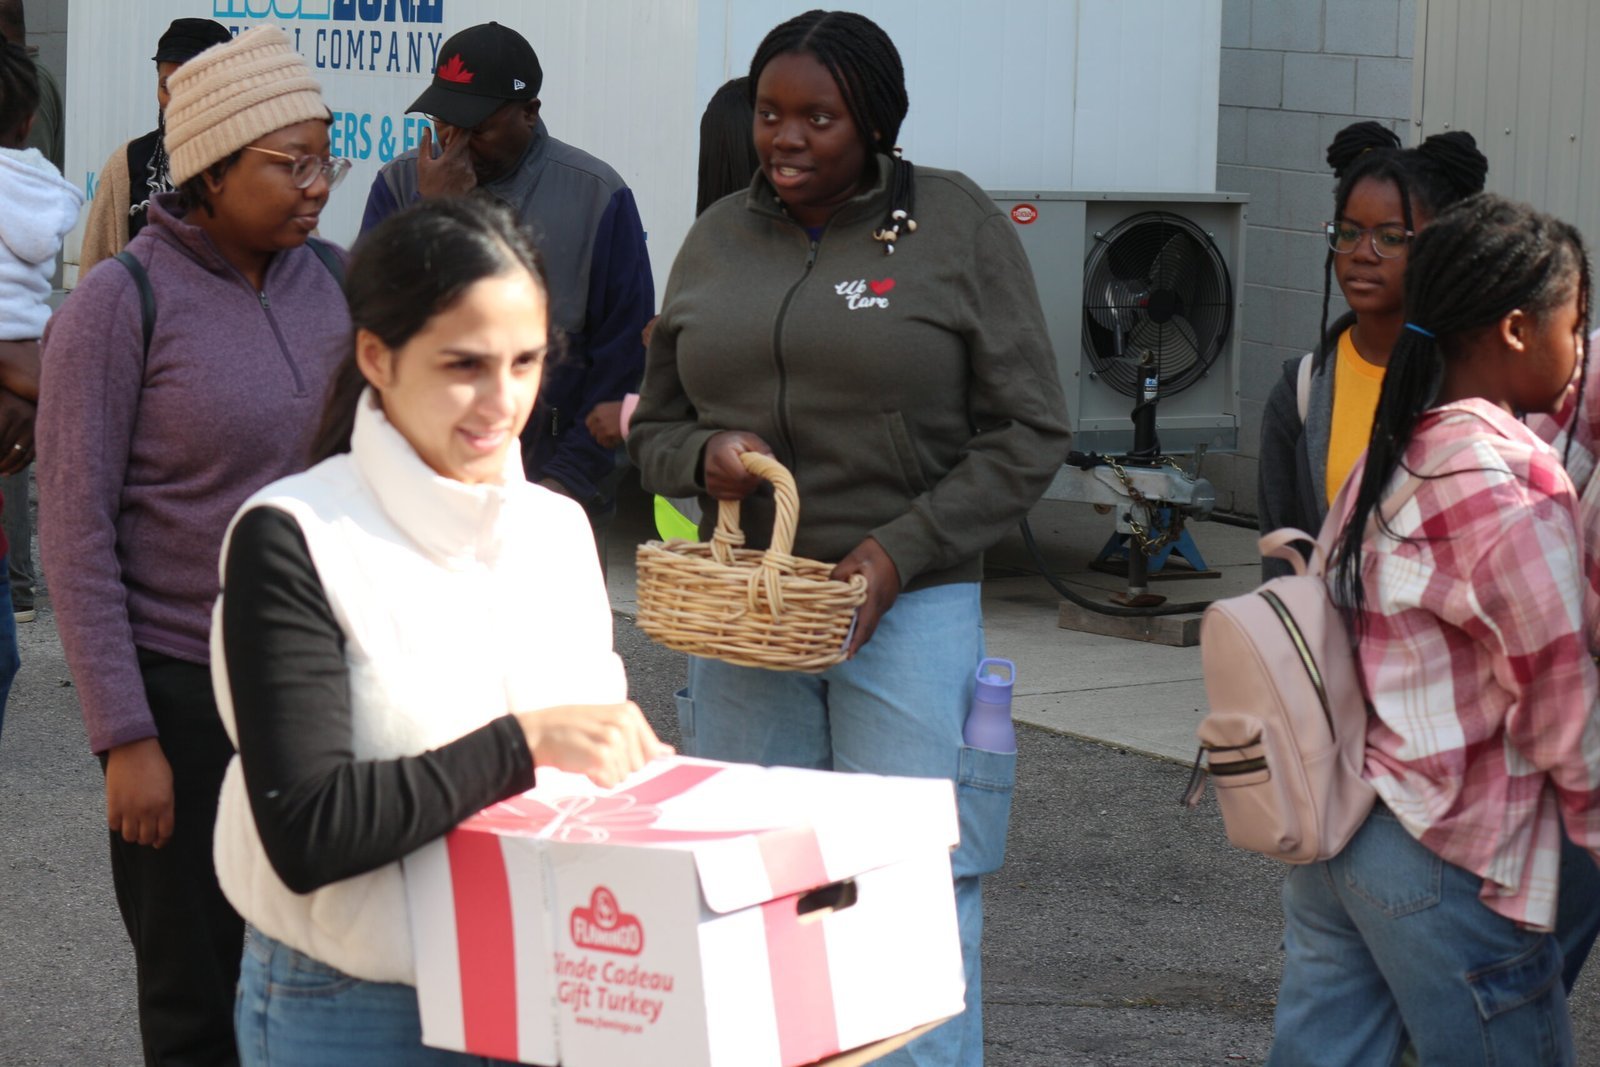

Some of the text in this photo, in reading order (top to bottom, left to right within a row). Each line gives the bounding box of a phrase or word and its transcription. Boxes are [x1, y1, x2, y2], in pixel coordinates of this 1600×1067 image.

[316, 28, 442, 75] COMPANY
[379, 115, 396, 163] &
[834, 279, 867, 295] We
[845, 293, 890, 310] Care
[602, 960, 675, 993] Cadeau
[557, 980, 664, 1025] Gift Turkey
